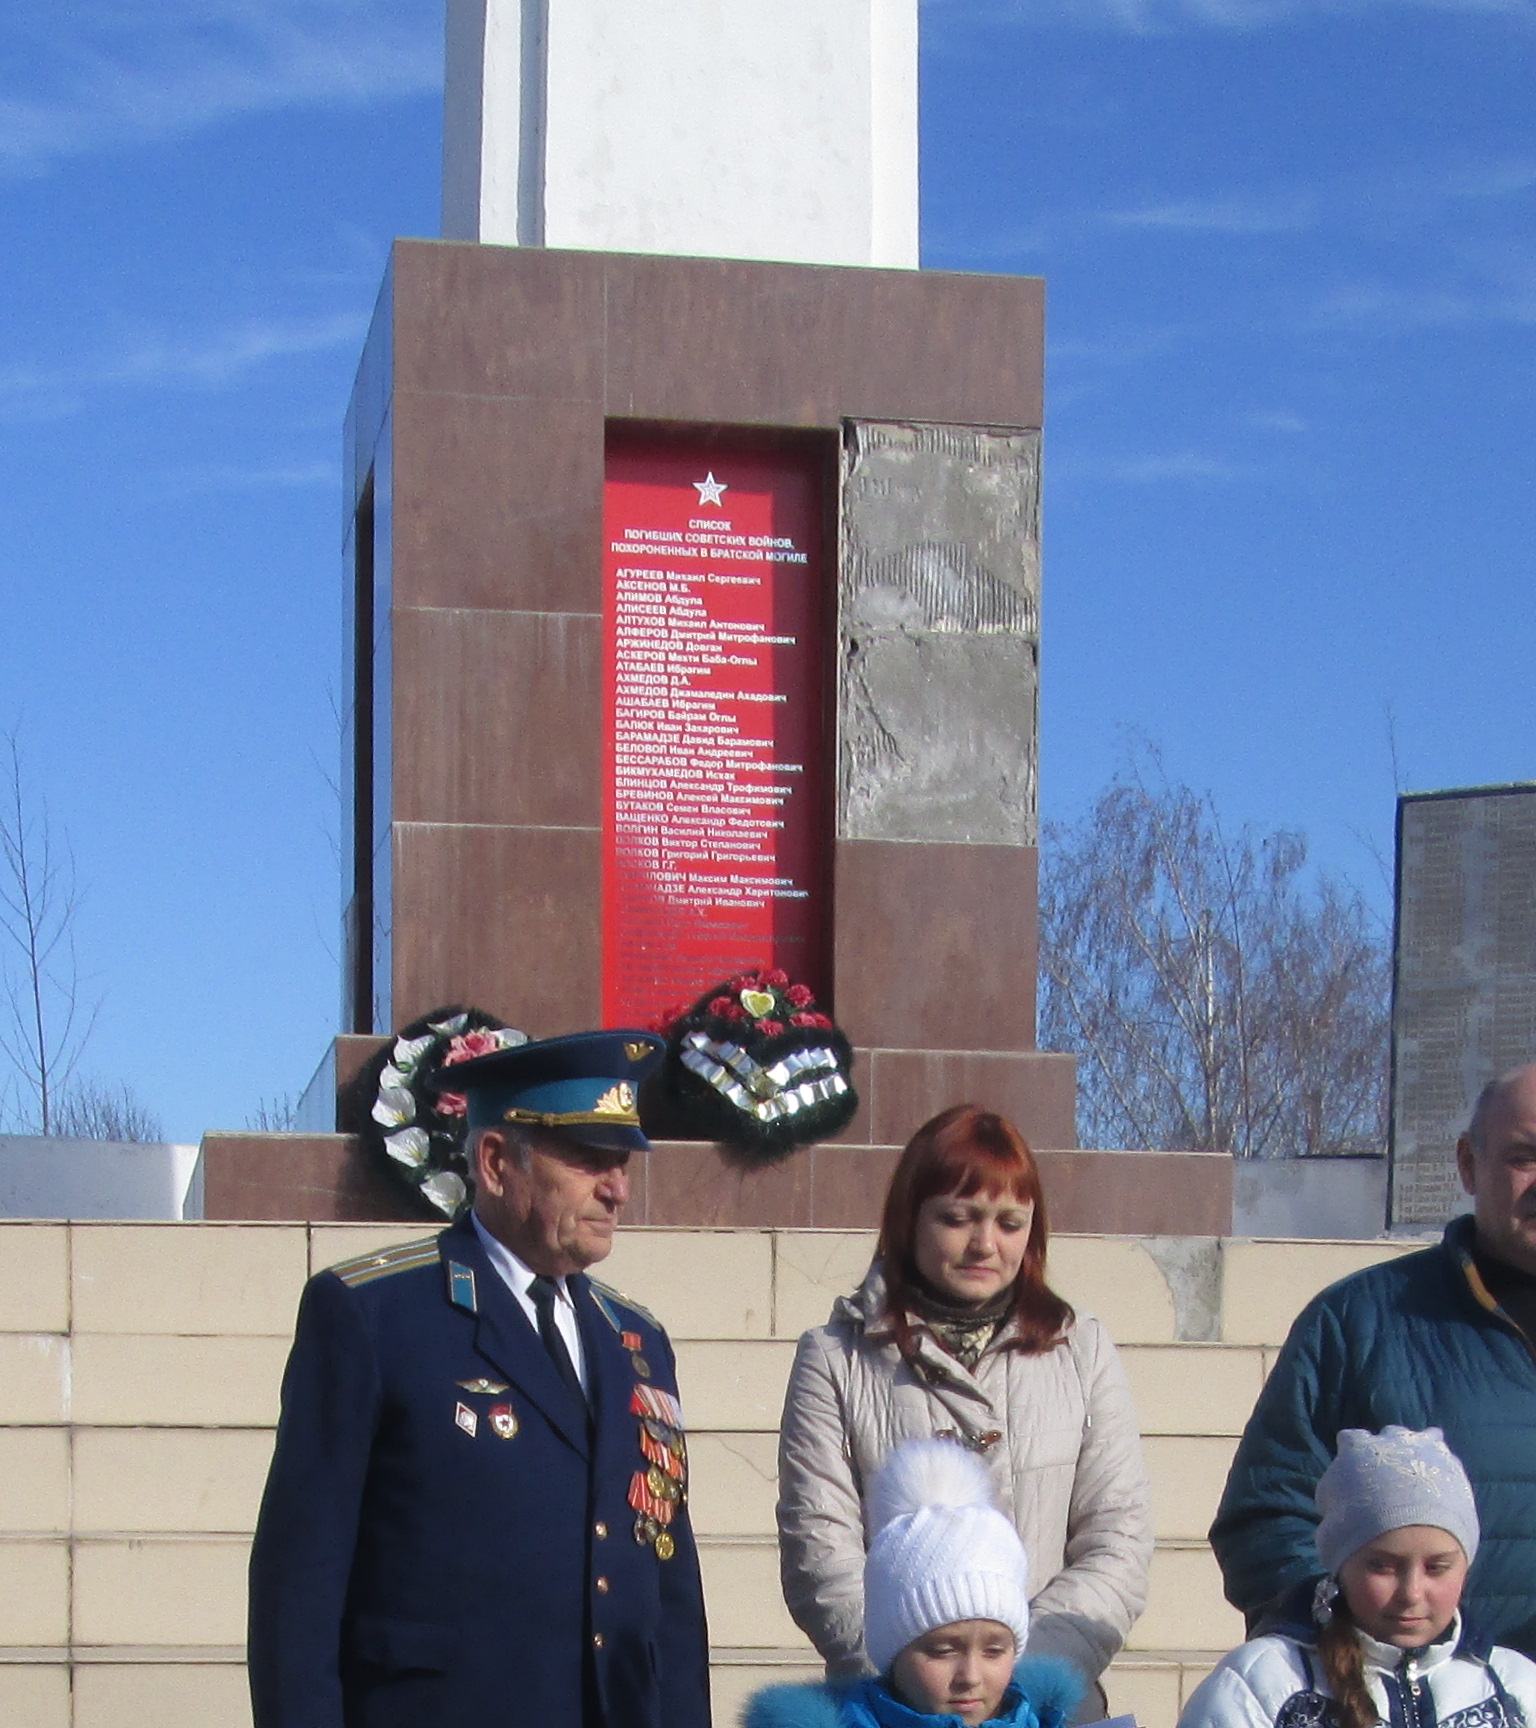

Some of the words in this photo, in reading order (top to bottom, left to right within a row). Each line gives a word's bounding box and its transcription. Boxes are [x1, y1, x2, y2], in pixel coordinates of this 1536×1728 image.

[689, 519, 732, 531] СПИСОК
[625, 529, 683, 543] ПОГИБШИХ
[685, 532, 746, 546] СОВЕТСКИХ
[611, 542, 699, 557] ПОХОРОНЕННЫХ
[700, 547, 708, 558] В
[710, 546, 764, 561] БРАТСКОЙ
[766, 551, 808, 565] МОГИЛЕ
[616, 568, 663, 580] АГУРЕЕВ
[667, 571, 705, 582] Михаил
[707, 573, 760, 586] Сергеевич
[616, 580, 667, 591] АКСЕНОВ
[669, 583, 691, 593] М.Б.
[616, 591, 662, 603] АЛИМОВ
[665, 594, 703, 606] Абдула
[616, 603, 666, 615] АЛИСЕЕВ
[669, 606, 707, 618] Абдула
[616, 614, 665, 626] АЛТУХОВ
[668, 617, 706, 628] Михаил
[709, 619, 764, 631] Антонович
[616, 626, 668, 638] АЛФЕРОВ
[670, 629, 716, 642] Дмитрий
[718, 632, 796, 646] Митрофанович
[616, 649, 665, 661] АСКЕРОВ
[616, 661, 664, 673] АТАБАЕВ
[667, 664, 711, 676] Ибрагим
[616, 672, 667, 685] АХМЕДОВ
[670, 675, 691, 686] Д.А.
[616, 685, 667, 697] АХМЕДОВ
[615, 696, 669, 708] АШАБАЕВ
[672, 699, 715, 711] Ибрагим
[615, 708, 665, 719] БАГИРОВ
[668, 710, 706, 722] Байрам
[709, 712, 736, 722] Оглы
[615, 719, 654, 730] БАЛЮК
[657, 721, 682, 731] Иван
[685, 723, 739, 735] Захарович
[615, 731, 679, 744] БАРАМАДЗЕ
[682, 735, 714, 746] Давид
[615, 743, 667, 754] БЕЛОВОЛ
[670, 745, 694, 755] Иван
[698, 747, 753, 759] Андреевич
[615, 754, 687, 766] БЕССАРАБОВ
[690, 758, 723, 769] Федор
[726, 760, 803, 773] Митрофанович
[615, 766, 703, 780] БИКМУХАМЕДОВ
[615, 777, 667, 790] БЛИНЦОВ
[670, 780, 724, 792] Александр
[727, 782, 792, 795] Трофимович
[615, 789, 673, 801] БРЕВИНОВ
[676, 792, 718, 803] Алексей
[721, 794, 783, 806] Максимович
[615, 801, 663, 812] БУТАКОВ
[666, 803, 698, 813] Семен
[701, 805, 750, 816] Власович
[615, 812, 668, 825] ВАЩЕНКО
[671, 815, 725, 827] Александр
[728, 817, 784, 830] Федотович
[615, 824, 658, 835] ВОЛГИН
[661, 826, 704, 837] Василий
[707, 828, 767, 840] Николаевич
[661, 838, 697, 849] Виктор
[700, 840, 760, 851] Степанович
[662, 849, 708, 861] Григорий
[711, 851, 775, 864] Григорьевич
[689, 873, 727, 884] Максим
[730, 875, 793, 886] Максимович
[688, 885, 741, 897] Александр
[715, 898, 764, 909] Иванович
